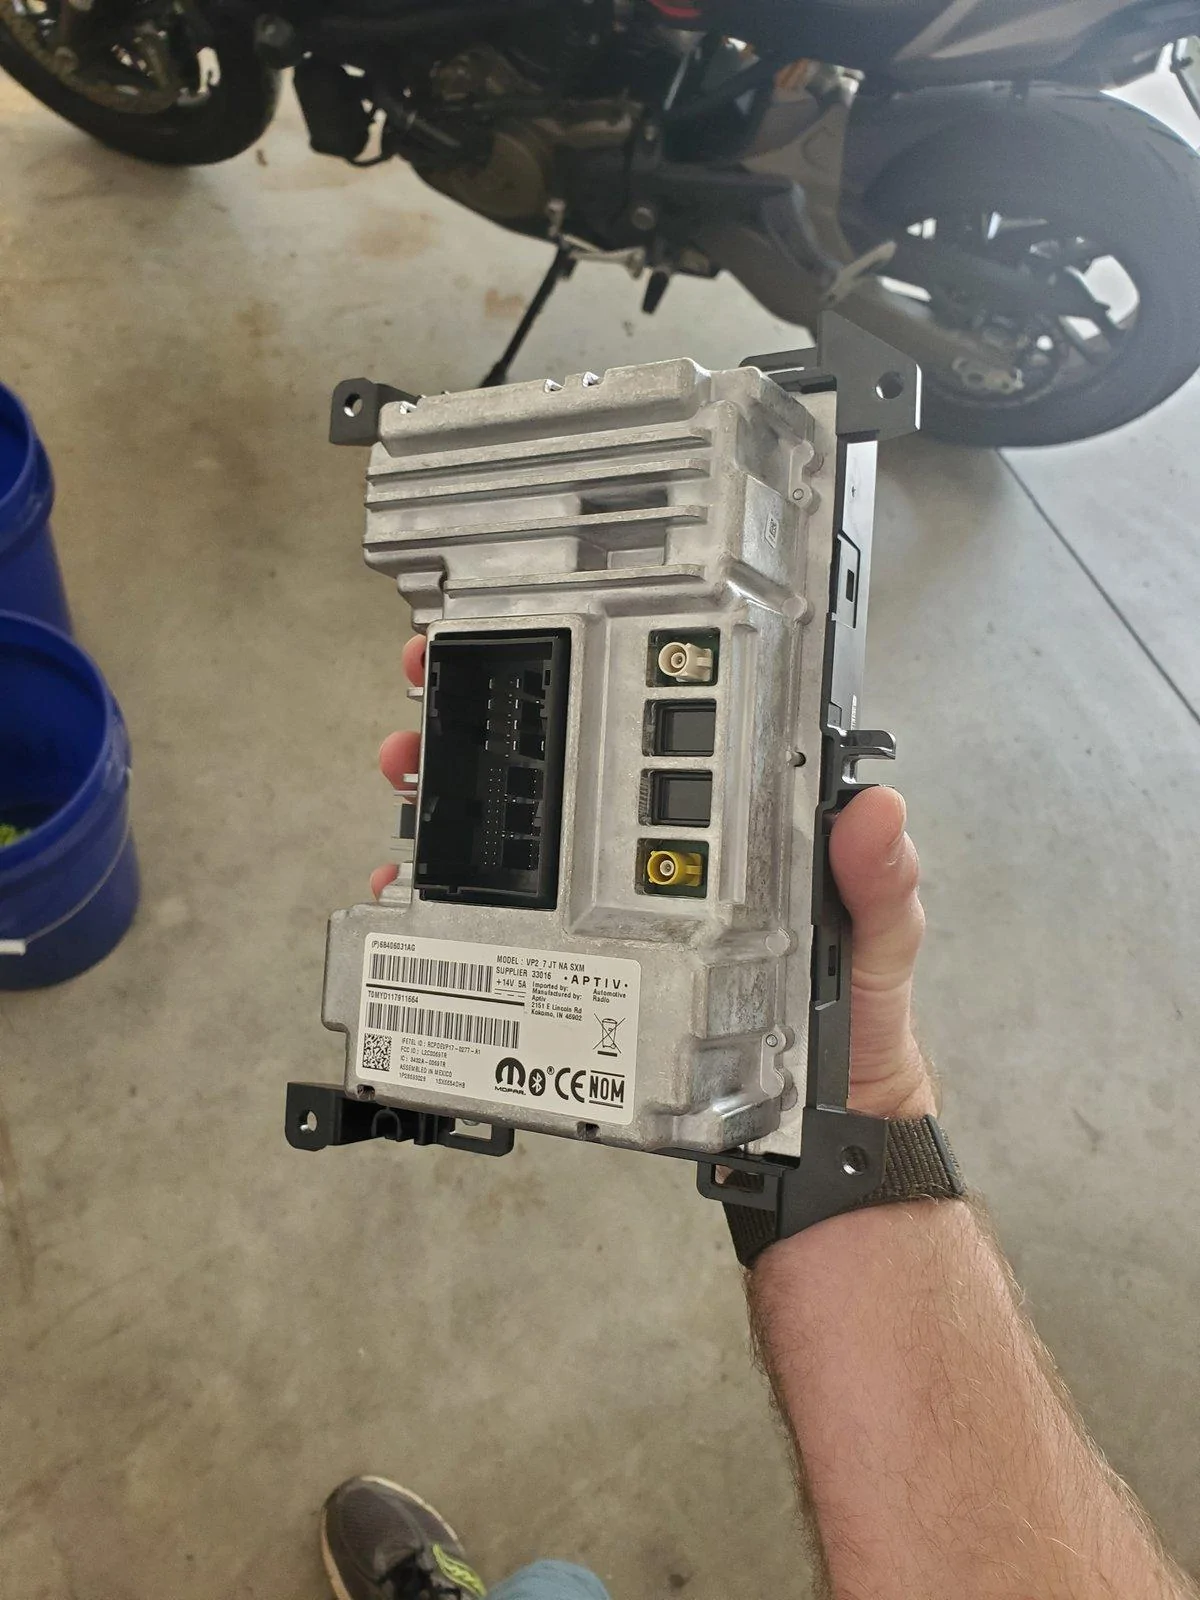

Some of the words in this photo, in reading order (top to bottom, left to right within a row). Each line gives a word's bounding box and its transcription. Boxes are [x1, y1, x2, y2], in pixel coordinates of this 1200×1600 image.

[497, 955, 519, 966] MODEL
[548, 961, 557, 969] JT
[558, 962, 568, 971] NA
[570, 963, 585, 972] SXM
[496, 966, 528, 978] SUPPLIER
[496, 979, 514, 988] +14V
[518, 979, 527, 989] 5A
[532, 981, 557, 992] Imported
[559, 984, 569, 993] by:
[531, 995, 546, 1003] Aptiv
[532, 988, 571, 999] Manufactured
[572, 992, 582, 1000] by:
[592, 988, 627, 999] Automotive
[592, 996, 610, 1004] Radio
[531, 1001, 545, 1009] 2151
[551, 1004, 572, 1013] Lincoln
[531, 1009, 555, 1018] Kokomo,
[400, 1064, 427, 1073] ASSEMBLED
[434, 1069, 453, 1077] MEXICO
[589, 1075, 625, 1103] NOM
